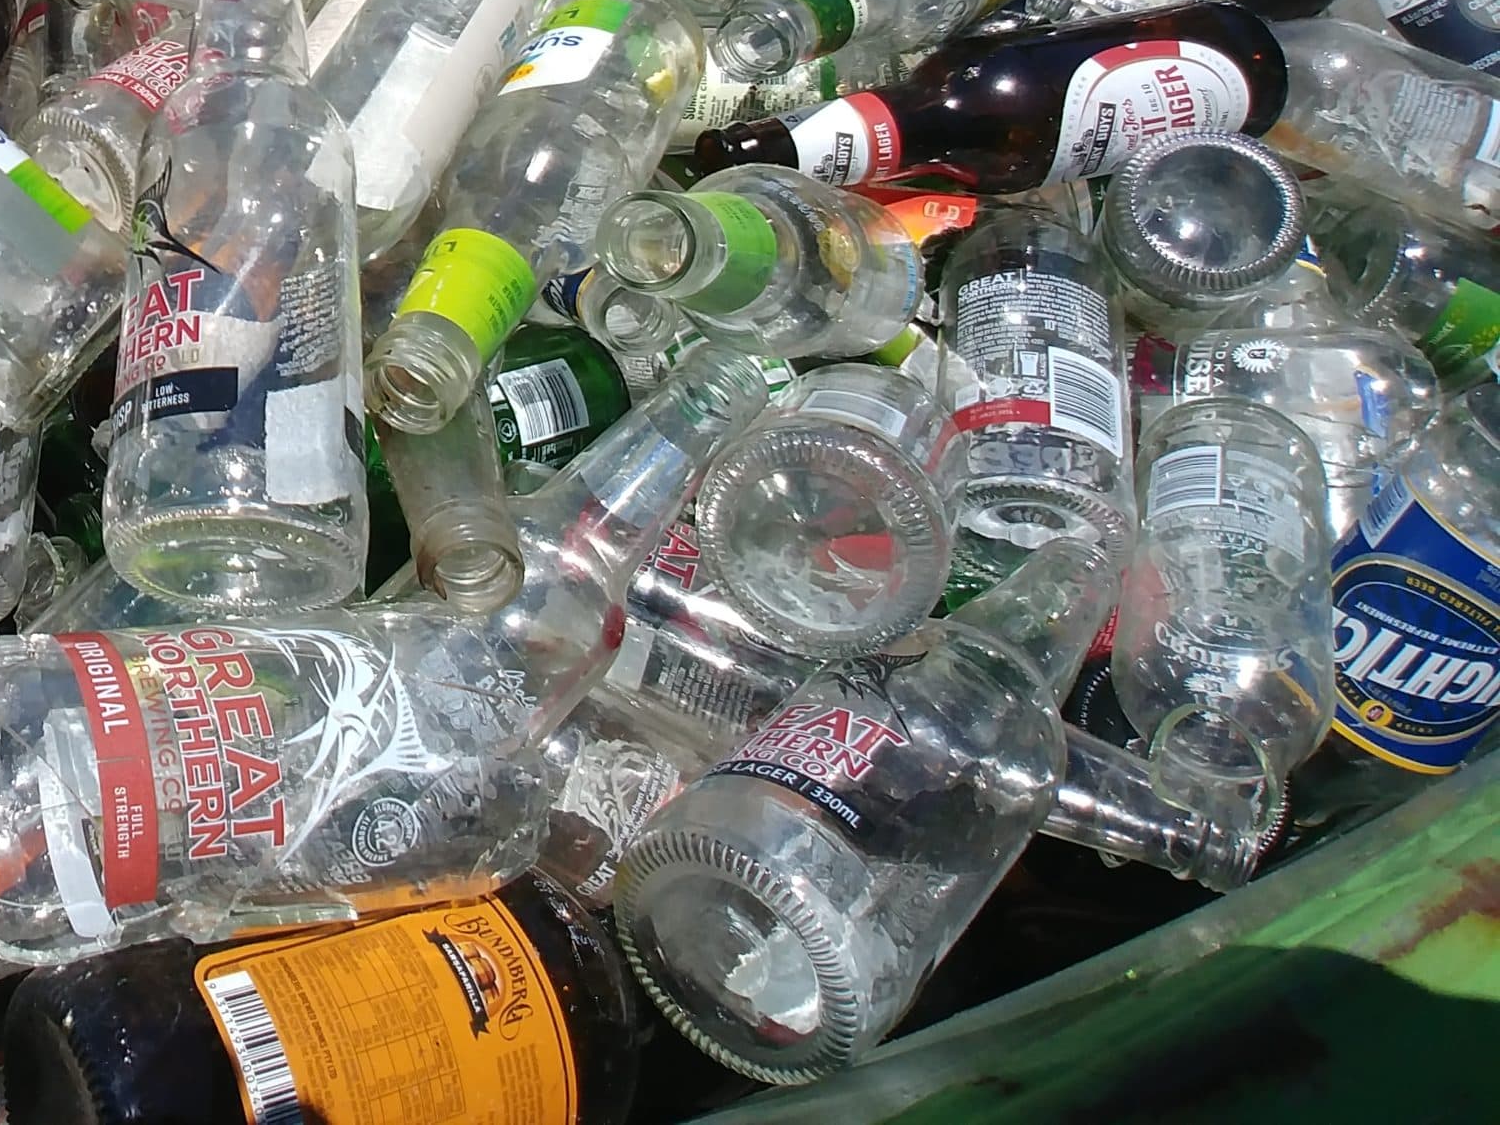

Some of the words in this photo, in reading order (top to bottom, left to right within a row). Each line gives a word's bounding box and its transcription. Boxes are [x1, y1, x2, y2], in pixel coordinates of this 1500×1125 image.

[1153, 64, 1196, 130] AGER
[877, 121, 893, 161] LAGER
[957, 271, 1017, 297] GREAT
[957, 282, 1018, 303] NORTHERN
[155, 383, 174, 397] LOW
[1404, 576, 1437, 595] BEER
[1354, 601, 1441, 645] REFRESHMENT
[1438, 592, 1493, 627] FILTERED
[1440, 636, 1498, 655] EXTREME
[74, 641, 131, 735] ORIGINAL
[130, 651, 177, 769] BREWING
[137, 631, 229, 861] NORTHERN
[179, 627, 286, 849] GREAT
[731, 760, 798, 785] LAGER
[809, 786, 864, 831] 330mL
[113, 785, 131, 860] STRENGTH
[130, 804, 145, 840] FULL
[575, 861, 617, 897] GREAT
[441, 941, 482, 1015] SARSAPARILLA
[443, 913, 535, 1041] BUNDABERG
